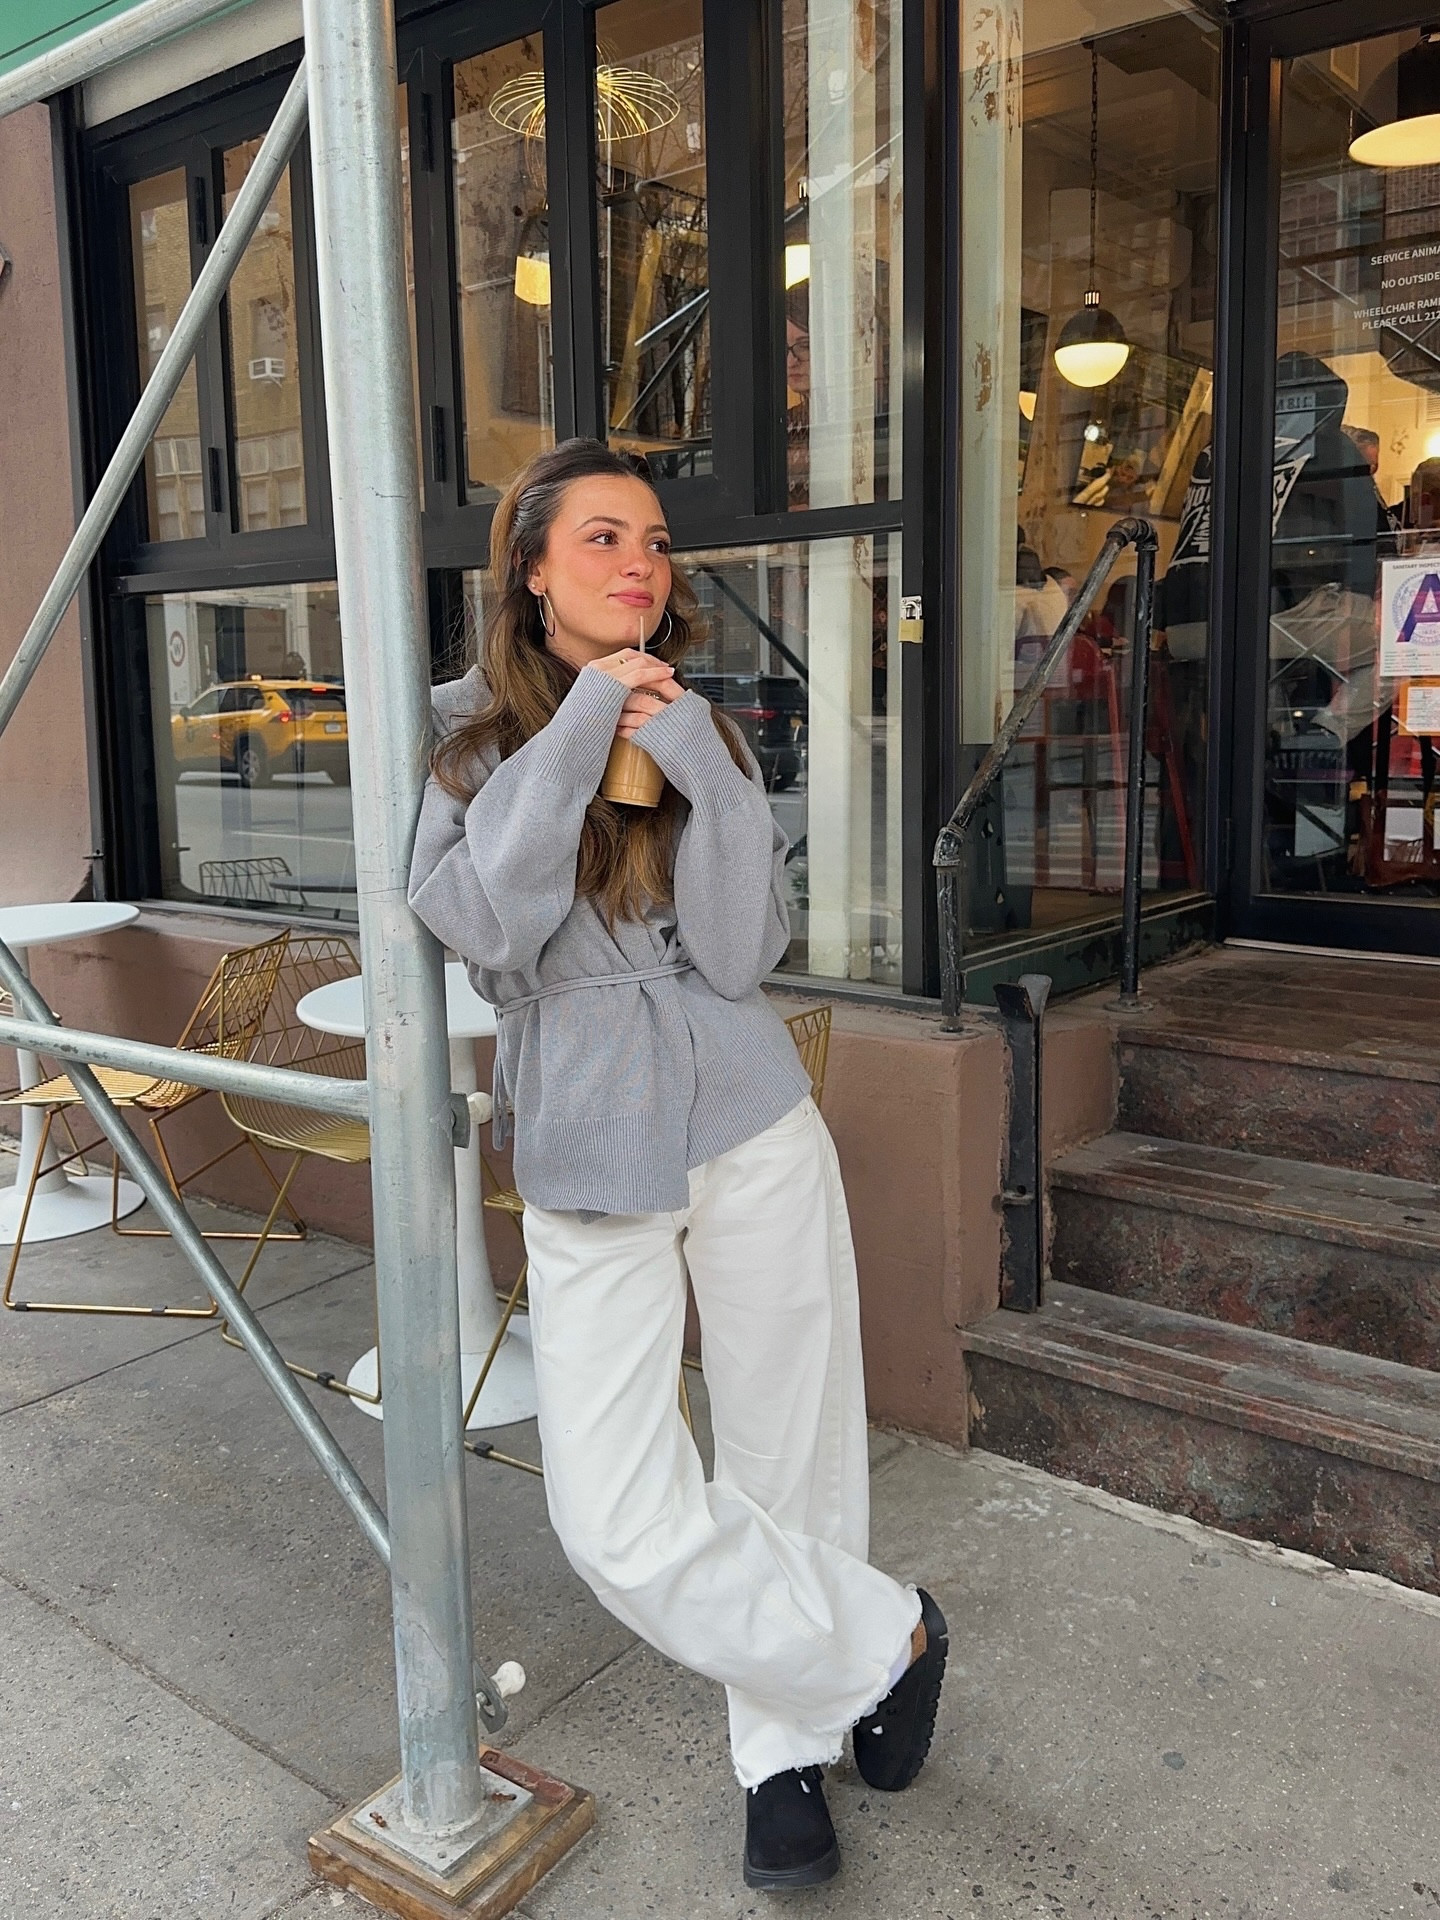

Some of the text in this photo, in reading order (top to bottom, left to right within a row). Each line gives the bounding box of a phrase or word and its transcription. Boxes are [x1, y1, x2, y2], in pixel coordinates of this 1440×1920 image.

[1370, 250, 1410, 266] SERVICE
[1381, 271, 1440, 289] NO OUTSIDE
[1353, 301, 1415, 319] WHEELCHAIR
[1362, 317, 1398, 330] PLEASE
[1399, 313, 1423, 325] CALL
[1396, 573, 1440, 643] A
